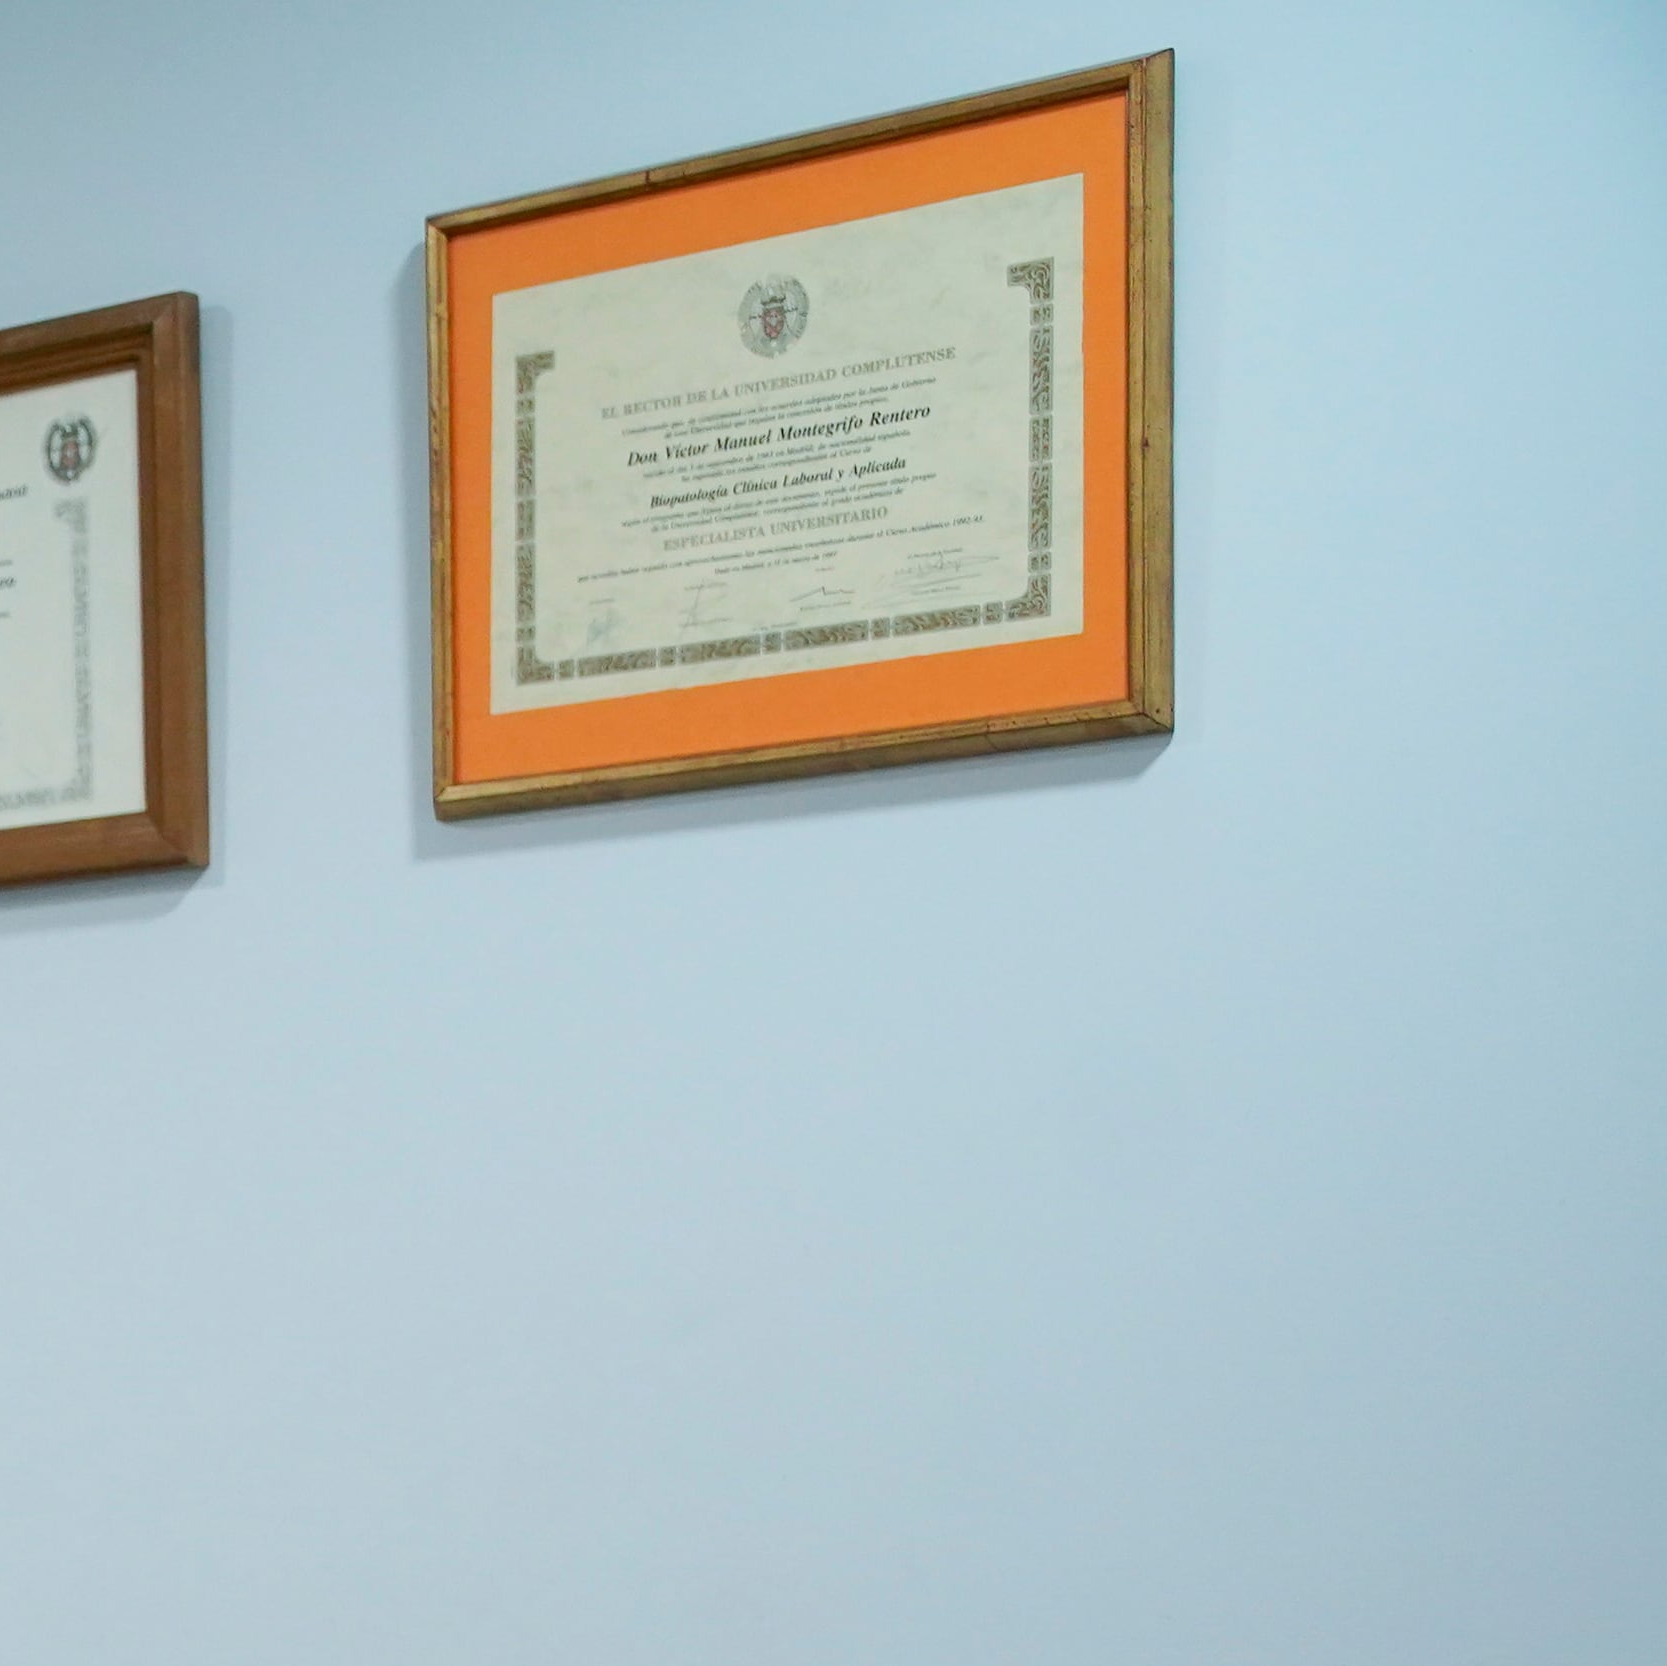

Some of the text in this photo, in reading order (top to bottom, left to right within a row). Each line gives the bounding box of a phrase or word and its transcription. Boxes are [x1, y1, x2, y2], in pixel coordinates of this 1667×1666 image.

[602, 407, 619, 418] EL
[623, 395, 682, 415] RECTOR
[687, 390, 707, 405] DE
[711, 387, 729, 401] LA
[735, 369, 837, 396] UNIVERSIDAD
[842, 346, 957, 377] COMPLUTENSE
[627, 450, 658, 467] Don
[713, 429, 772, 453] Manuel
[777, 415, 863, 442] Montegrifo
[870, 406, 931, 427] Rentero
[650, 484, 729, 509] Biopatología
[732, 477, 778, 496] Clínica
[782, 467, 834, 488] Laboral
[837, 469, 846, 482] y
[850, 456, 907, 479] Aplicada
[663, 525, 766, 552] ESPECIALISTA
[771, 506, 889, 535] UNIVERSITARIO
